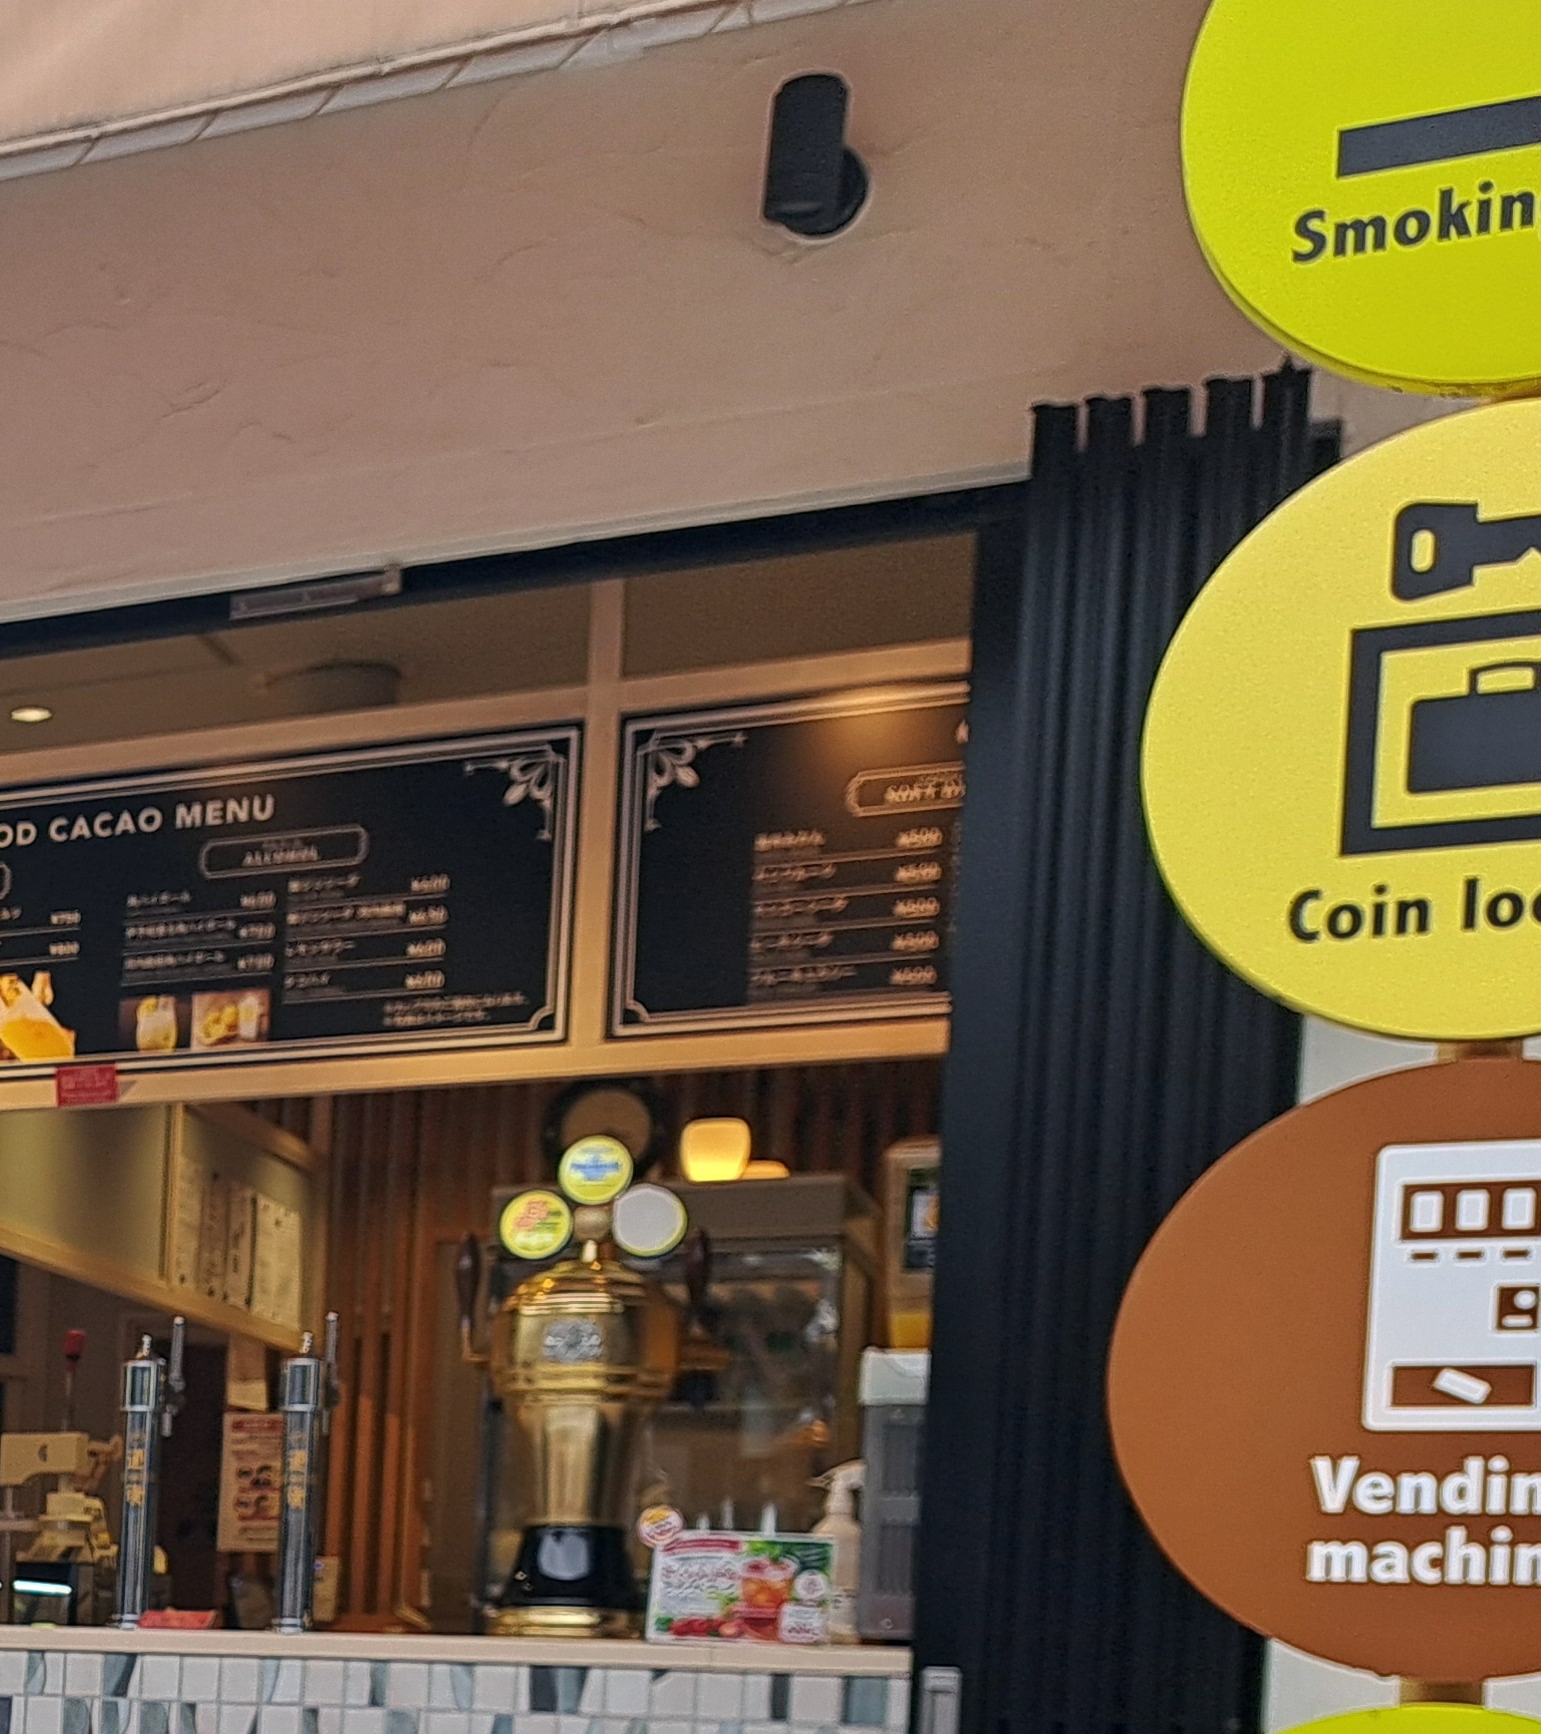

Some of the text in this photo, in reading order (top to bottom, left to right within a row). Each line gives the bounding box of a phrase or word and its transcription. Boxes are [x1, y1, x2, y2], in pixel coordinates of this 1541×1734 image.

[1292, 180, 1541, 264] Smokin
[48, 806, 163, 842] CACAO
[175, 794, 275, 829] MENU
[1289, 876, 1541, 942] Coin lo
[1308, 1455, 1541, 1515] Vendin
[1305, 1525, 1541, 1586] machin
